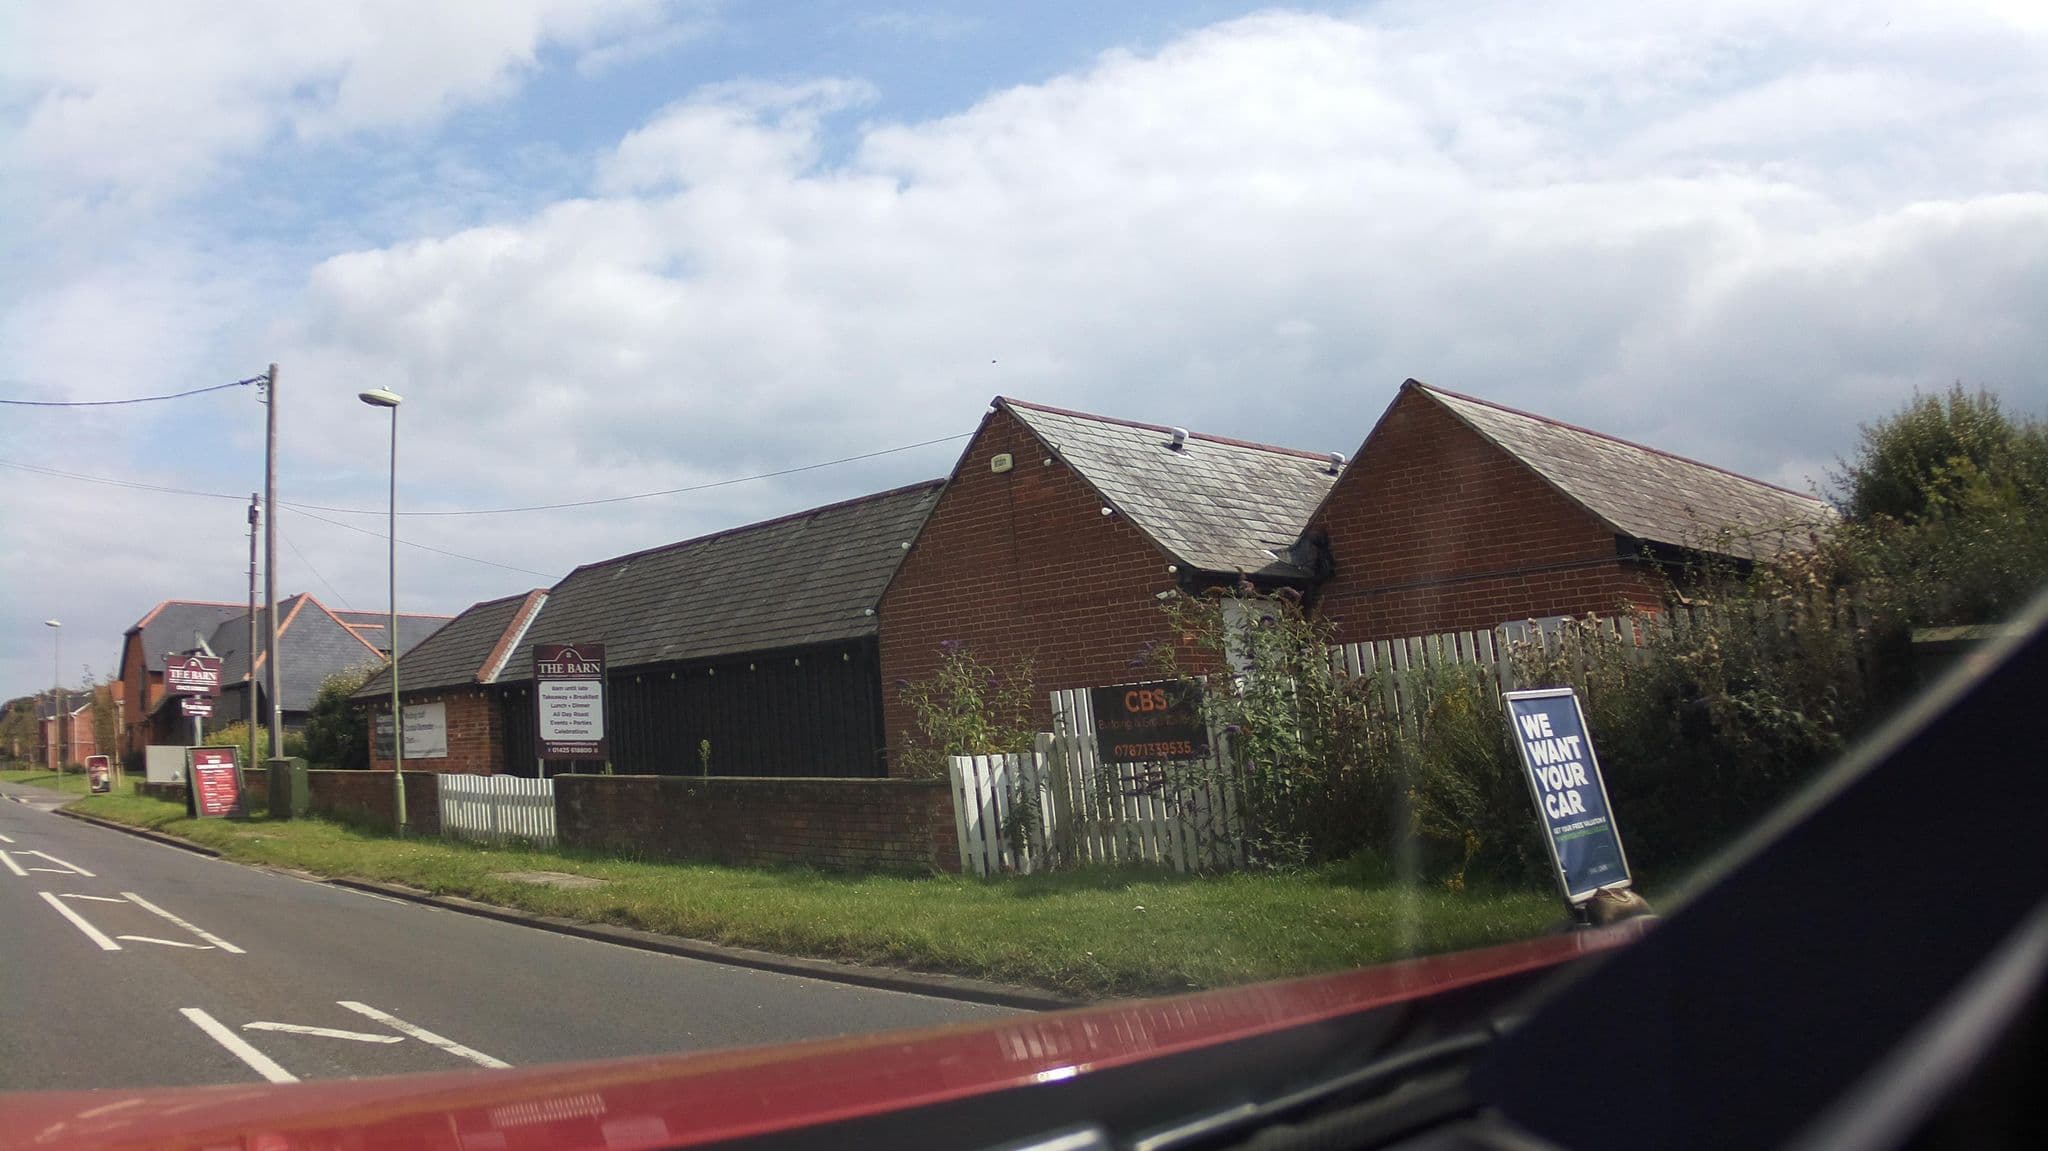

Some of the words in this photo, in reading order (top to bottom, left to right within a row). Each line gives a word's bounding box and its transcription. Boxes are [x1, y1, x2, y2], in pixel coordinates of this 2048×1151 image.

[169, 669, 190, 679] THE
[191, 670, 217, 681] BARN
[538, 663, 564, 674] THE
[567, 663, 601, 674] BARN
[1124, 688, 1167, 712] CBS
[1519, 713, 1554, 739] WE
[1527, 735, 1582, 766] WANT
[1535, 762, 1590, 792] YOUR
[1545, 790, 1587, 819] CAR
